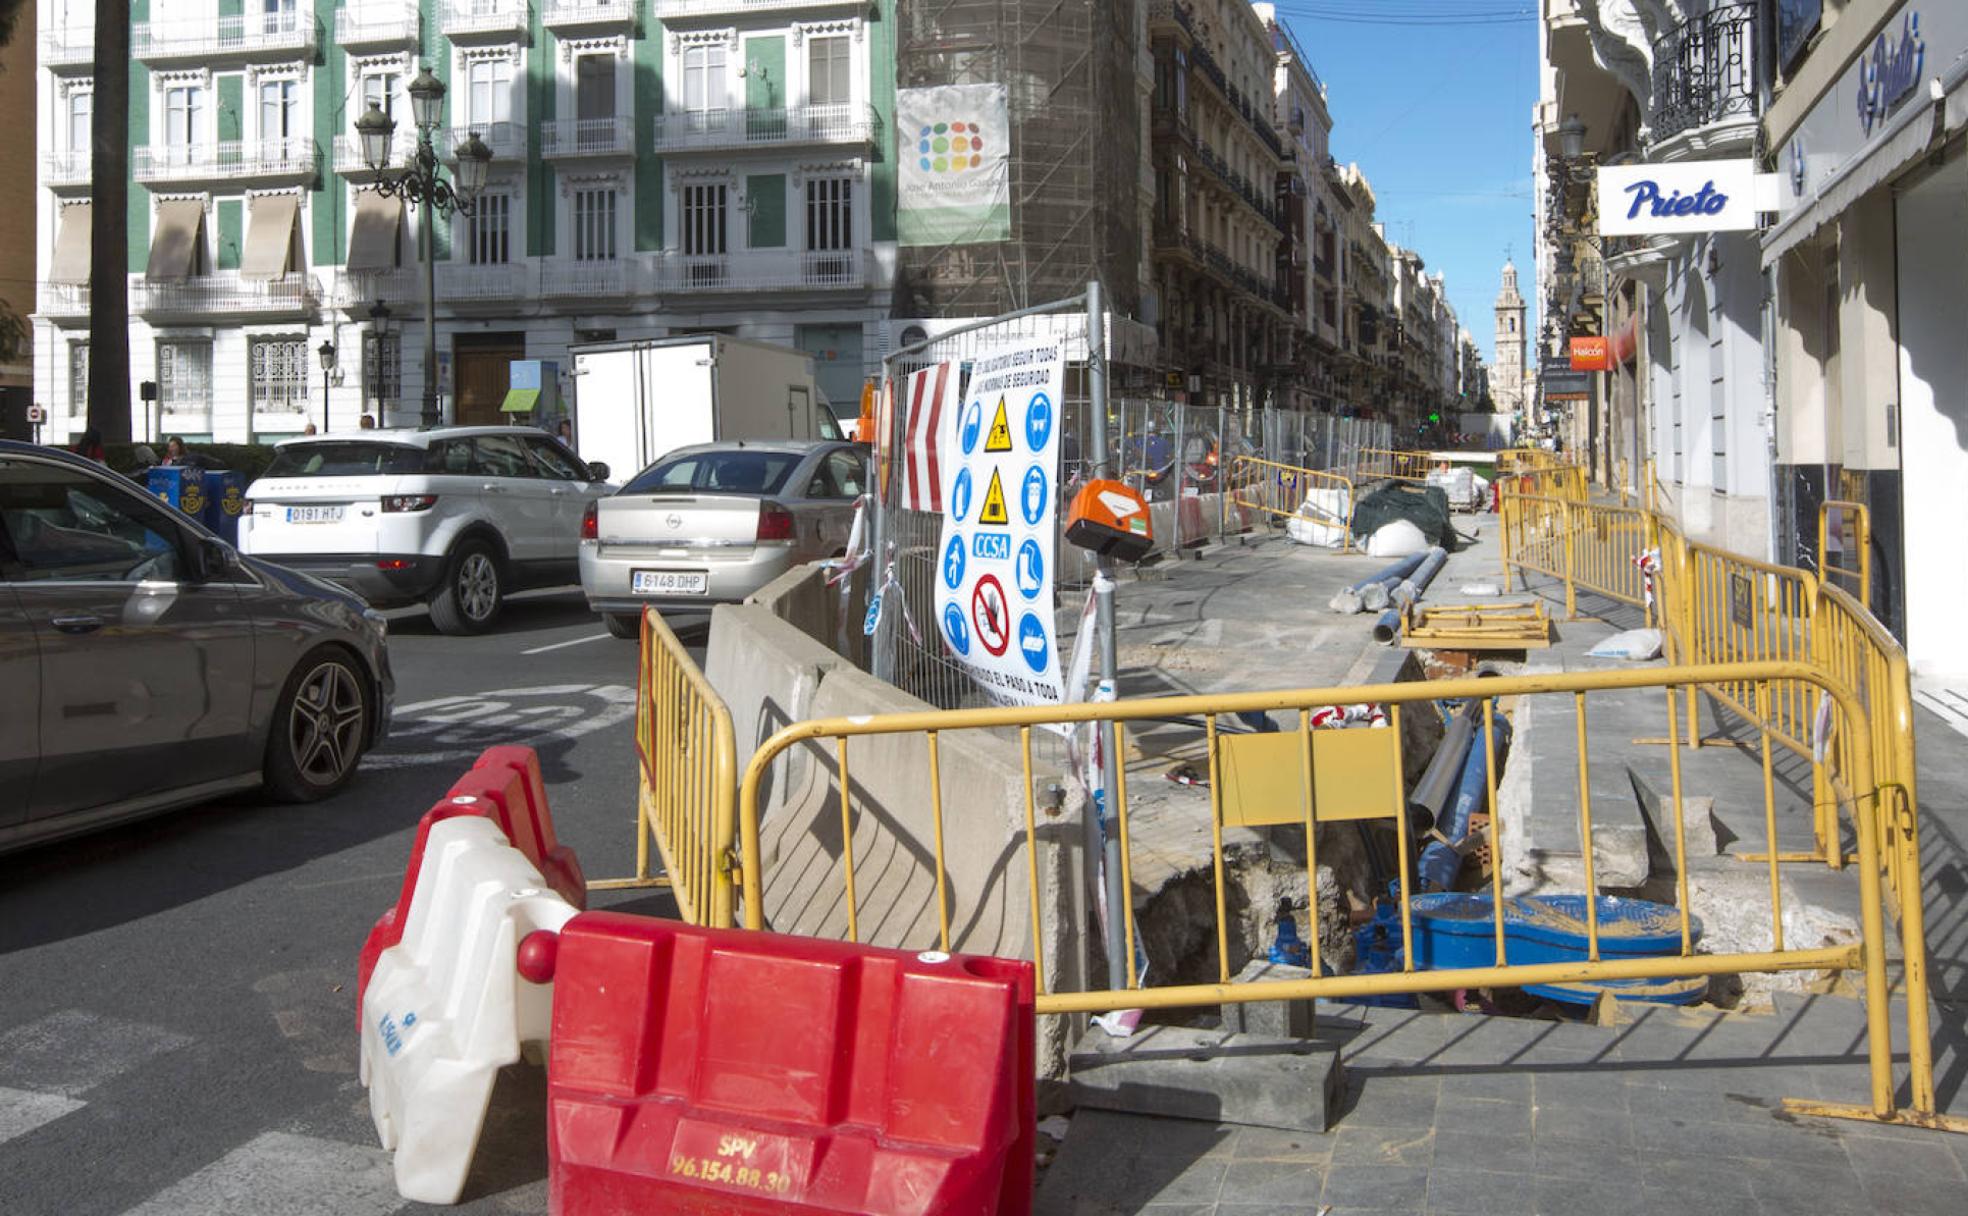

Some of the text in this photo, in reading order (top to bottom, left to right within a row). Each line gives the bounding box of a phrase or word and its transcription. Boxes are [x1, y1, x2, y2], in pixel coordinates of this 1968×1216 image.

[1624, 180, 1729, 219] Prieto
[1036, 345, 1058, 363] TODAS
[1012, 368, 1050, 388] SEGURIDAD
[293, 507, 344, 520] 0191 HTJ
[976, 535, 1007, 560] CCSA
[677, 575, 700, 588] DHP
[993, 671, 1005, 687] EL
[1005, 674, 1026, 692] PASO
[1034, 682, 1059, 702] TODA
[717, 1134, 757, 1159] SPV
[672, 1154, 790, 1194] 96.154.88.30
